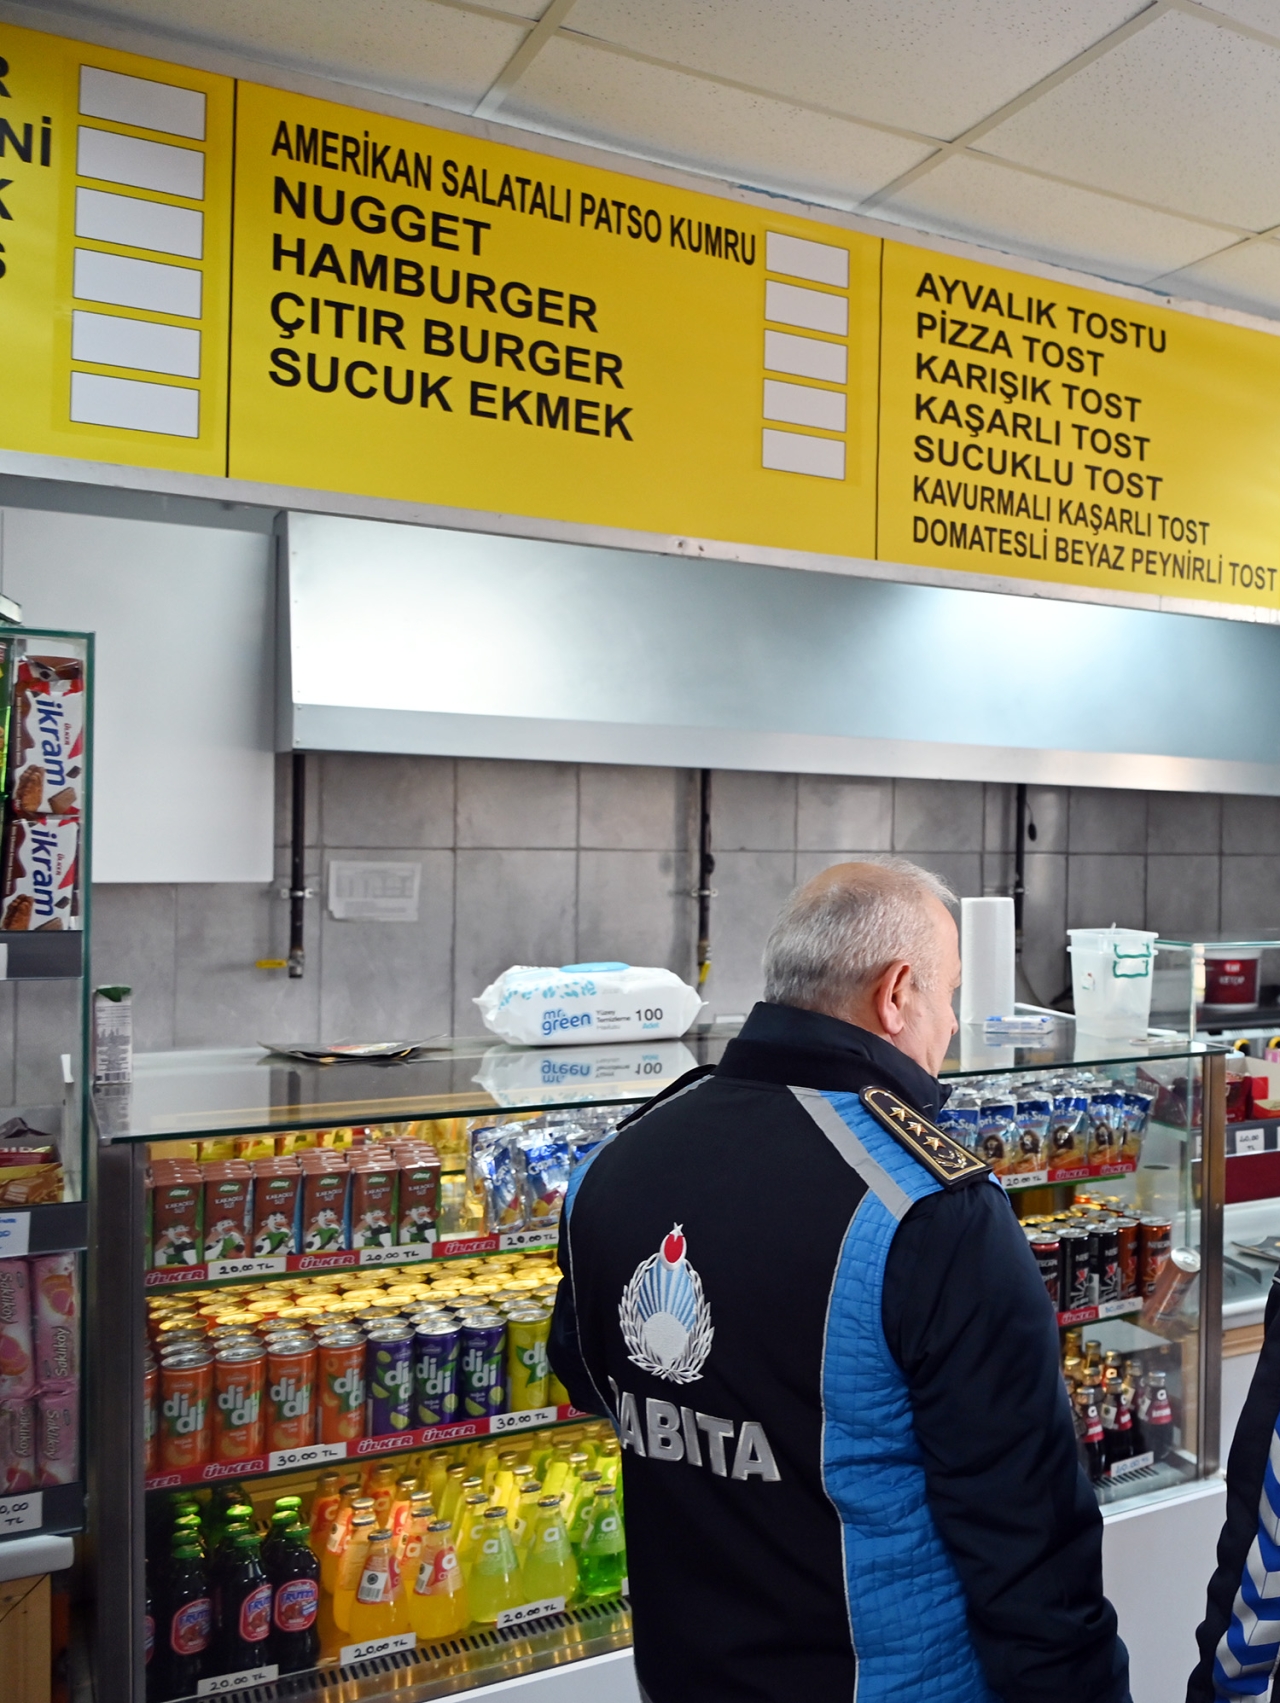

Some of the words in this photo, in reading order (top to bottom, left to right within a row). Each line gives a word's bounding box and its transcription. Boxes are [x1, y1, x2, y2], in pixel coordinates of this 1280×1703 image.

[271, 120, 432, 192] AMERİKAN
[441, 159, 572, 224] SALATALI
[579, 192, 662, 244] PATSO
[670, 214, 756, 266] KUMRU
[273, 175, 492, 256] NUGGET
[272, 232, 598, 333] HAMBURGER
[915, 272, 1057, 329] AYVALIK
[1066, 306, 1167, 354] TOSTU
[270, 291, 406, 351] ÇITIR
[423, 318, 624, 390] BURGER
[917, 311, 1013, 359] PİZZA
[1021, 335, 1105, 377] TOST
[268, 347, 453, 413] SUCUK
[469, 380, 634, 442] EKMEK
[916, 352, 1052, 406] KARIŞIK
[1061, 382, 1142, 423] TOST
[915, 392, 1061, 446] KAŞARLI
[1071, 423, 1151, 462] TOST
[913, 434, 1073, 487] SUCUKLU
[1084, 464, 1164, 501] TOST
[913, 474, 1051, 522] KAVURMALI
[1058, 498, 1152, 537] KAŞARLI
[1157, 514, 1210, 546] TOST
[913, 515, 1048, 561] DOMATESLİ
[1055, 536, 1125, 571] BEYAZ
[1131, 547, 1223, 584] PEYNİRLİ
[1228, 561, 1278, 591] TOST
[36, 698, 66, 787] ikram
[30, 828, 58, 917] ikram
[542, 1013, 591, 1036] green
[635, 1008, 664, 1022] 100
[145, 1269, 205, 1286] ÜLKER
[256, 1262, 274, 1271] TL
[299, 1255, 355, 1270] ÜLKER
[403, 1250, 420, 1258] TL
[445, 1239, 496, 1255] ÜLKER
[145, 1474, 181, 1490] KER
[203, 1459, 264, 1479] ÜLKER
[322, 1449, 338, 1457] TL
[357, 1435, 414, 1453] ÜLKER
[422, 1424, 476, 1443] ÜLKER
[535, 1413, 549, 1421] TL
[608, 1376, 782, 1482] ABITA
[4, 1517, 24, 1526] TL
[393, 1638, 408, 1647] TL
[544, 1603, 557, 1612] TL
[252, 1673, 267, 1681] TL
